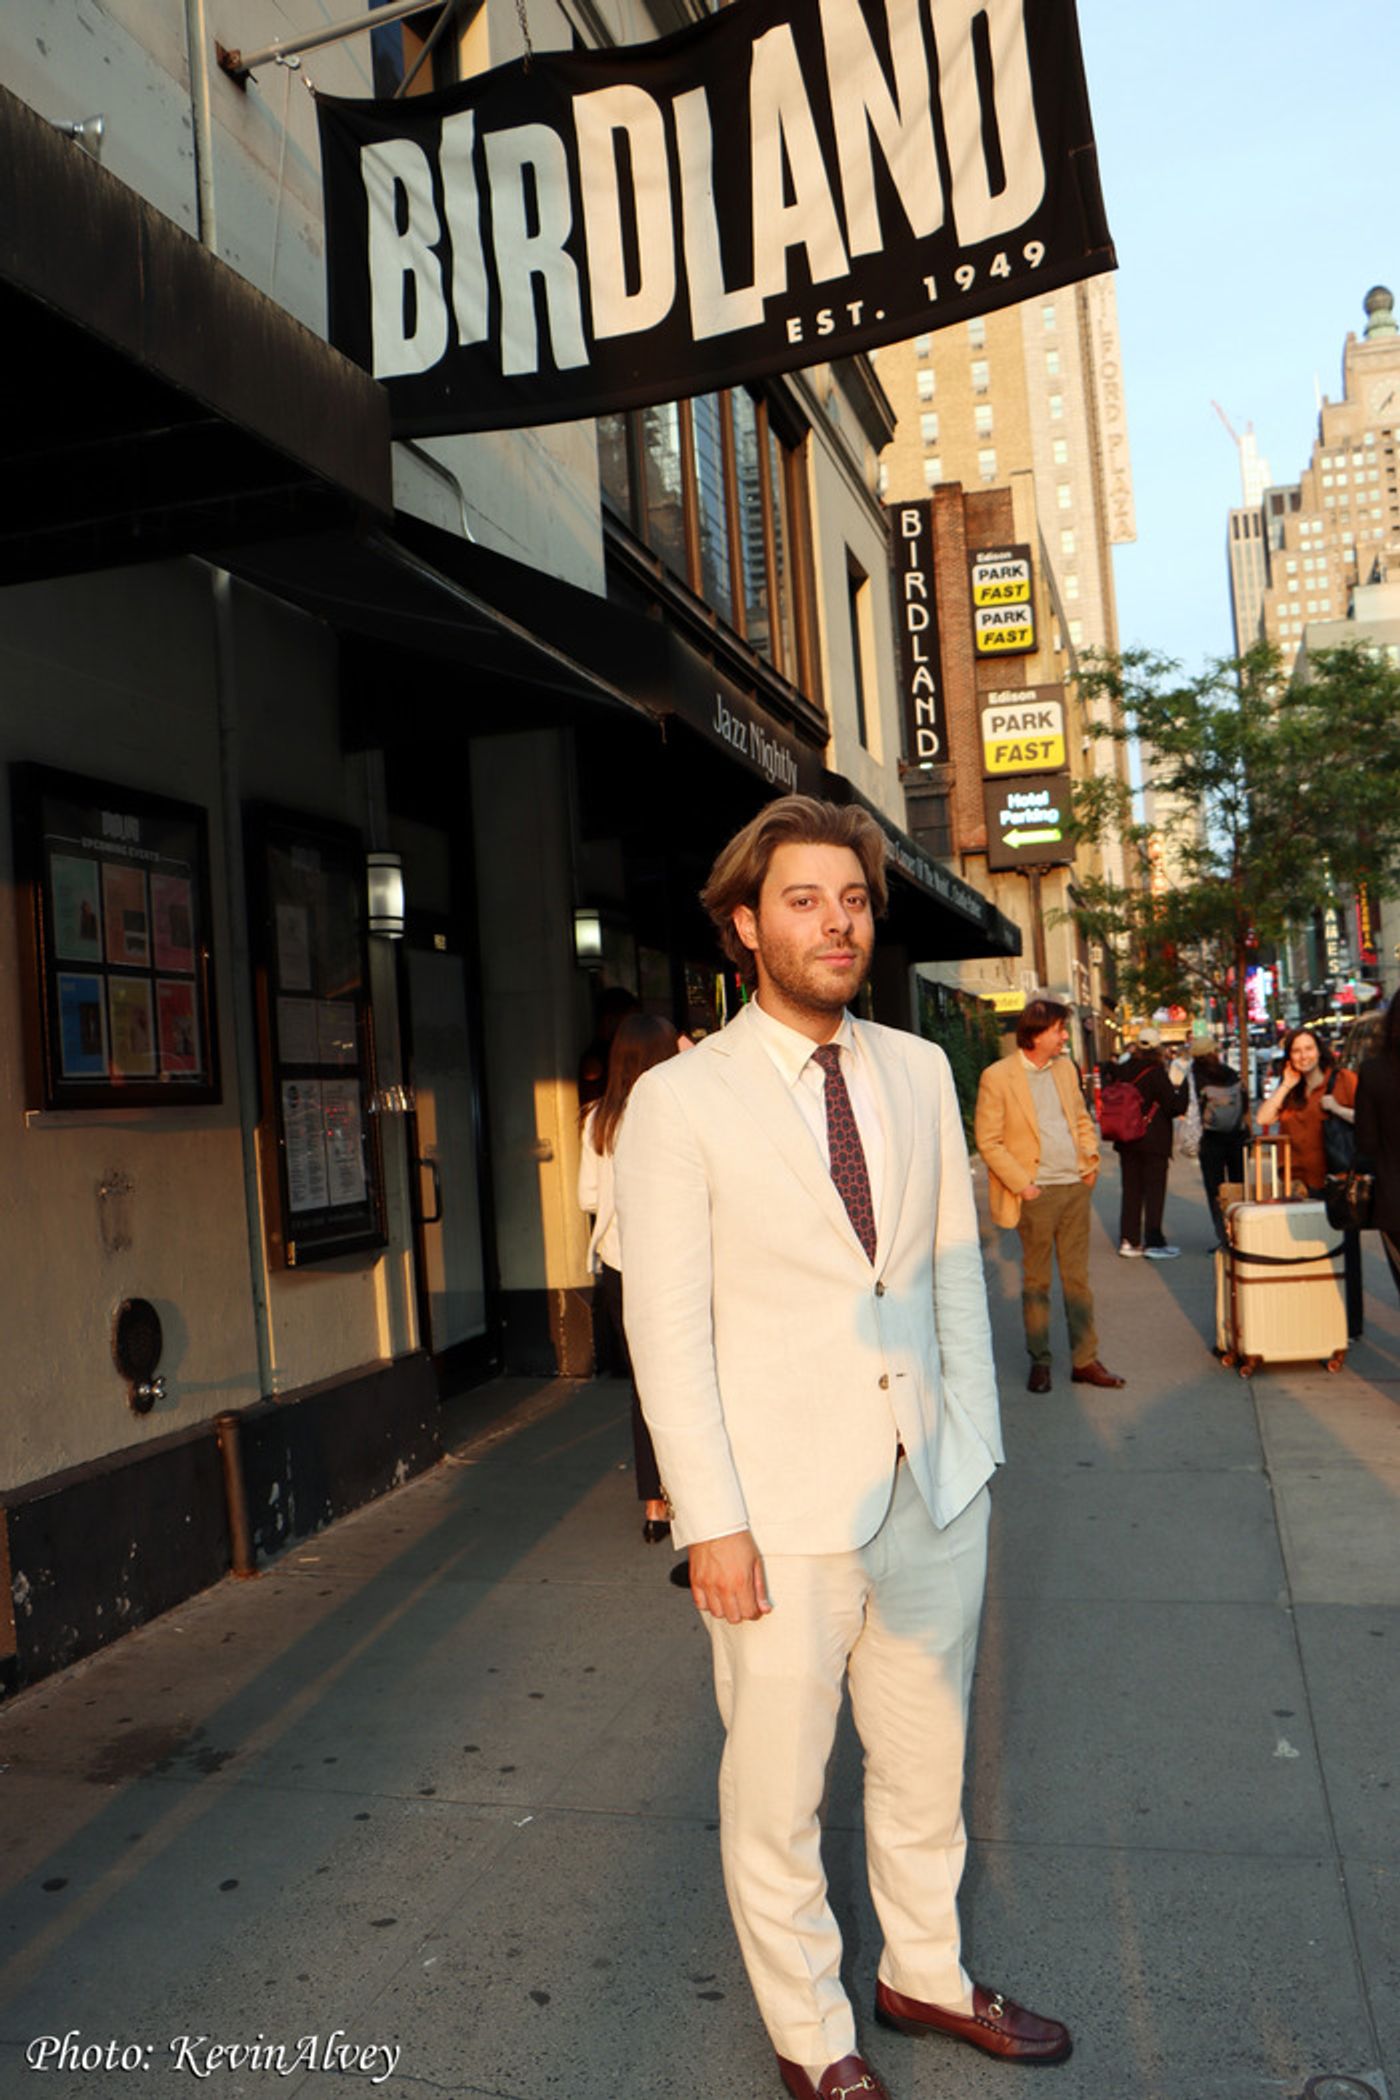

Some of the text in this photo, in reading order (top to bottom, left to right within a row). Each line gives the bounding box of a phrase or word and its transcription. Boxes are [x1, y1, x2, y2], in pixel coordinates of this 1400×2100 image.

[360, 0, 1047, 382] BIRDLAND
[787, 240, 1047, 344] EST. 1949
[1107, 433, 1132, 541] PLAZA
[978, 563, 1024, 582] PARK
[980, 583, 1025, 600] FAST
[982, 608, 1027, 626] PARK
[901, 509, 940, 757] BIRDLAND
[984, 628, 1029, 646] FAST
[988, 689, 1037, 704] Edison
[991, 710, 1054, 734] PARK
[713, 693, 798, 793] Jazz Nightly
[994, 740, 1055, 764] FAST
[1007, 790, 1050, 808] Hotel
[1000, 806, 1060, 826] Parking
